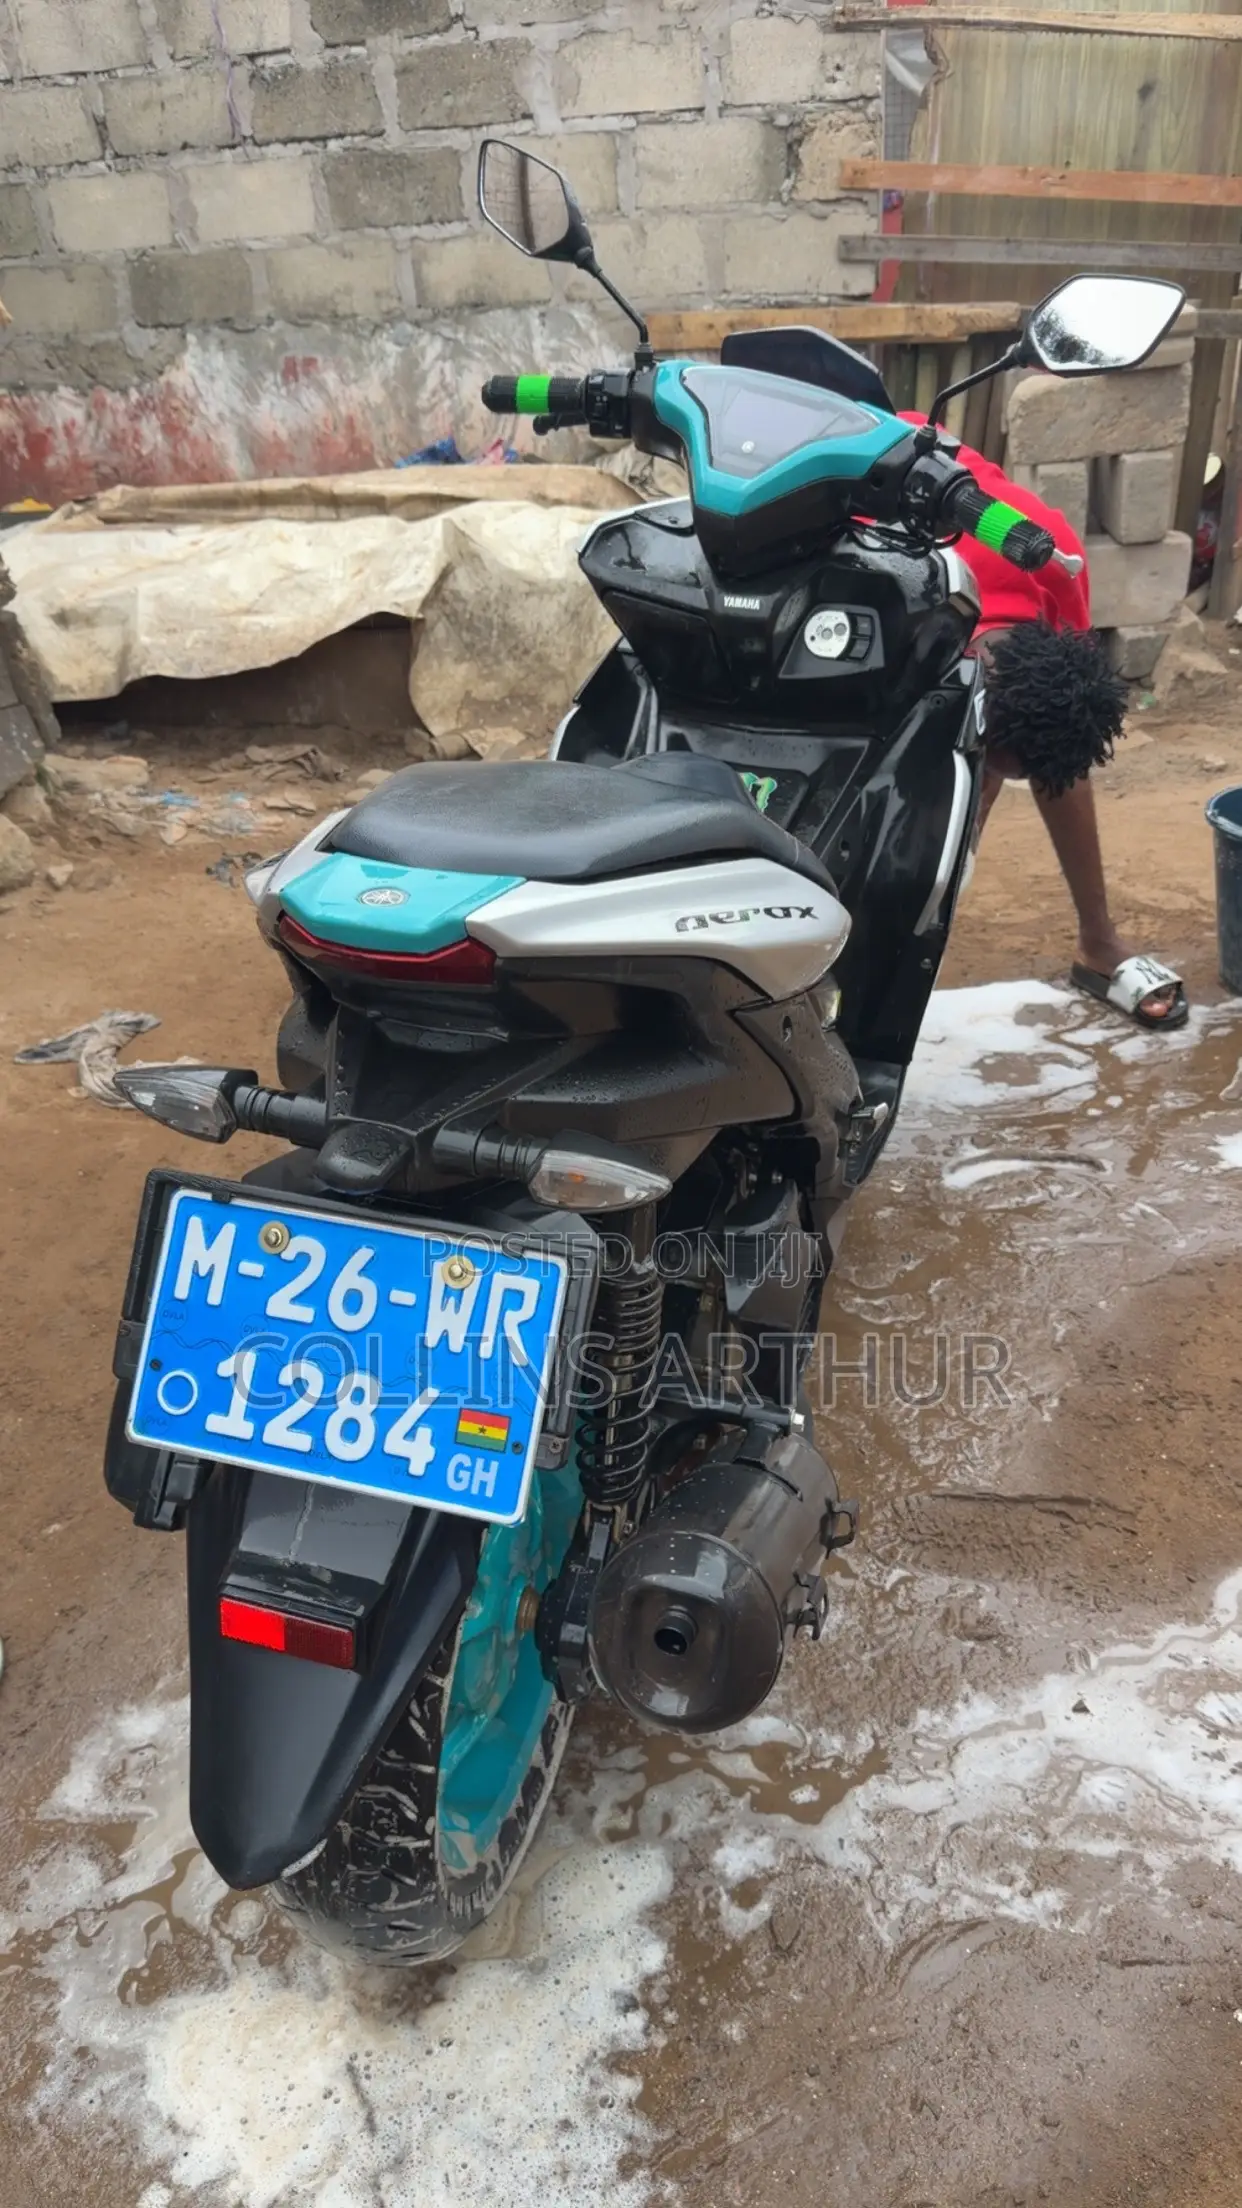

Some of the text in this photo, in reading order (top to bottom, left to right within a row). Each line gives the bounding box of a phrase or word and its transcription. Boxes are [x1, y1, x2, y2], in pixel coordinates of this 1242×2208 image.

[724, 596, 761, 610] YAMAHA
[174, 1214, 541, 1367] M-26-WR
[204, 1349, 440, 1477] 1284
[446, 1453, 499, 1498] GH
